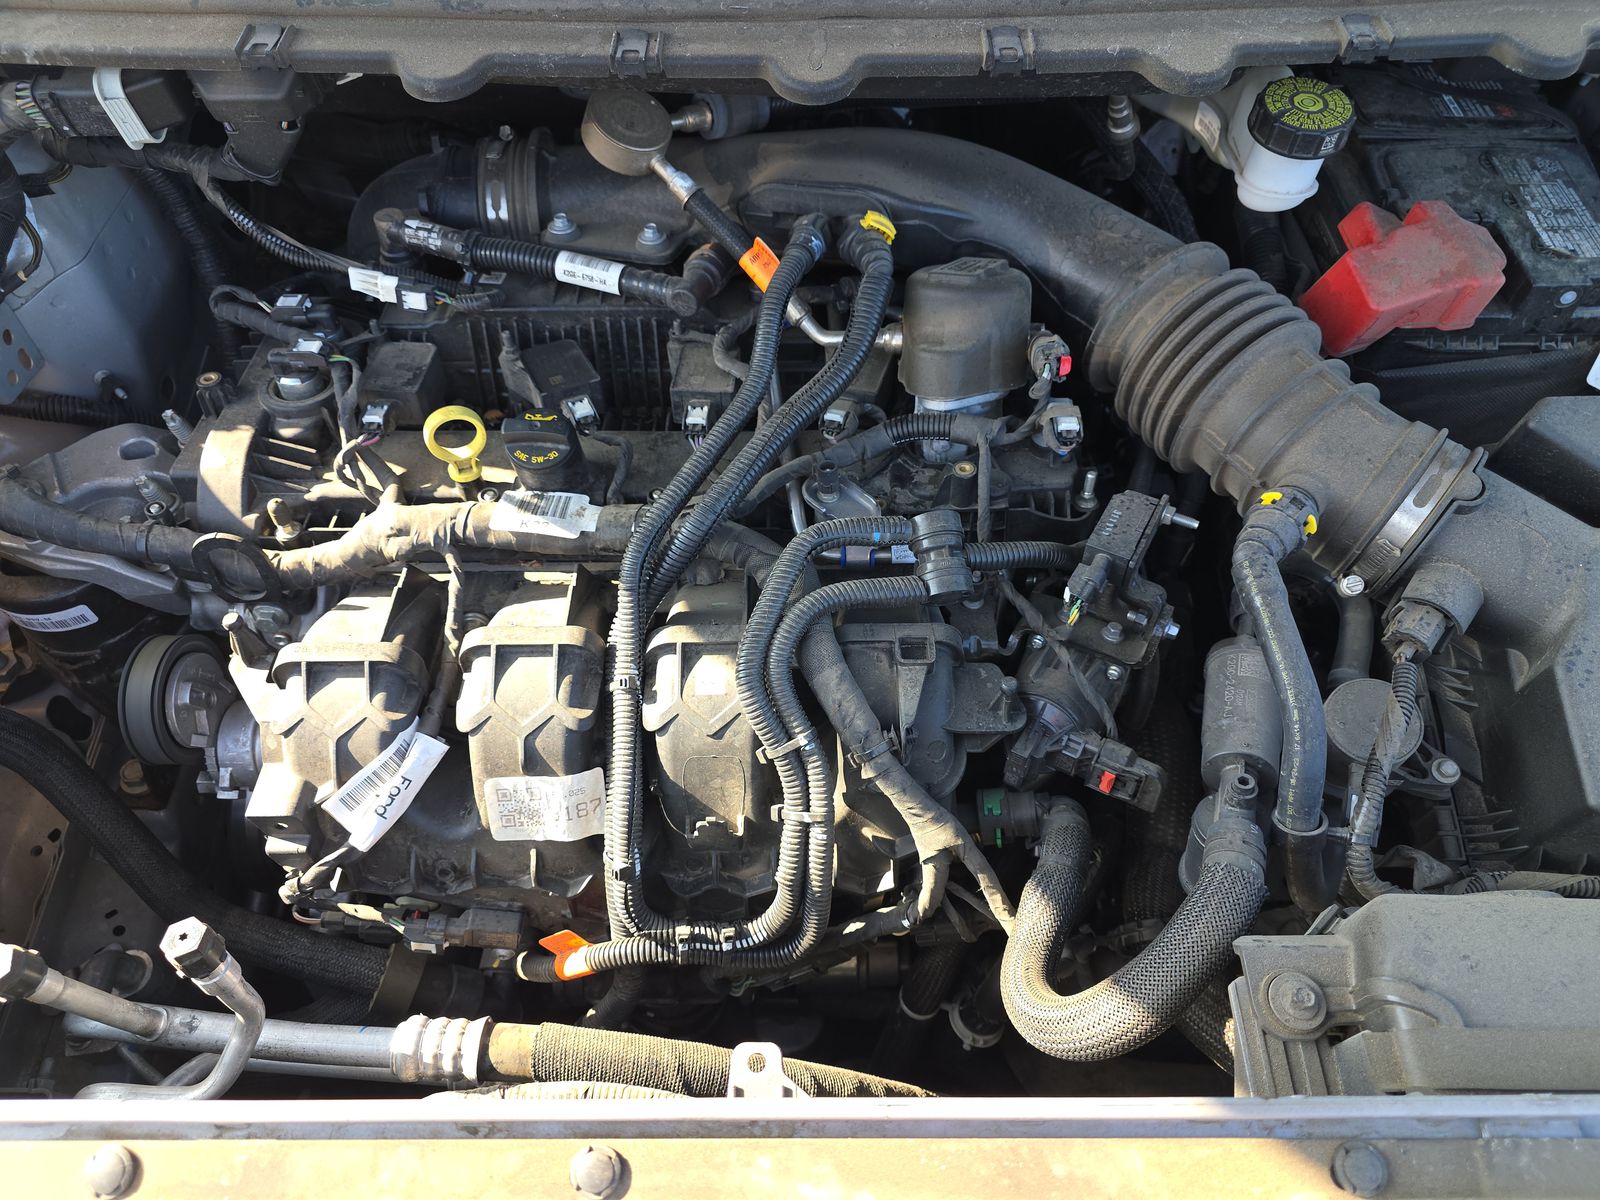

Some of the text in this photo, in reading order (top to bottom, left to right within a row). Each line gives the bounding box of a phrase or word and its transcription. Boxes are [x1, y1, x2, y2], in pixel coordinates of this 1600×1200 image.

[514, 450, 559, 463] SAE 5W-30
[374, 775, 413, 820] Ford
